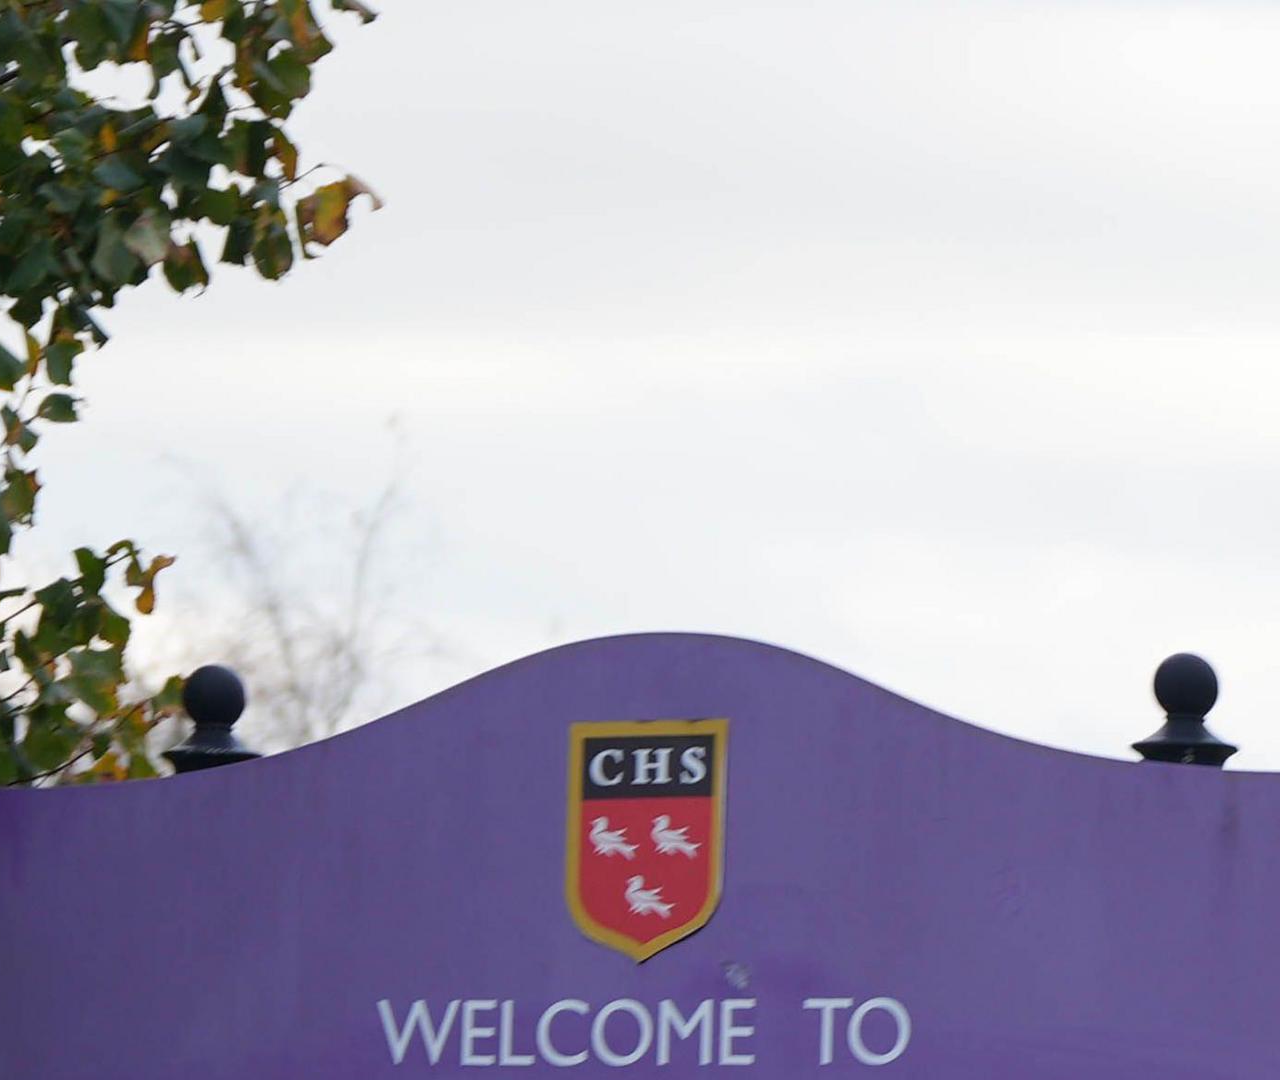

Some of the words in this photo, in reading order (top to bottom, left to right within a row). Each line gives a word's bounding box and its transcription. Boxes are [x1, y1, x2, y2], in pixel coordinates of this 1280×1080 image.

[589, 746, 708, 787] CHS
[377, 998, 757, 1068] WELCOME
[802, 997, 911, 1067] TO
